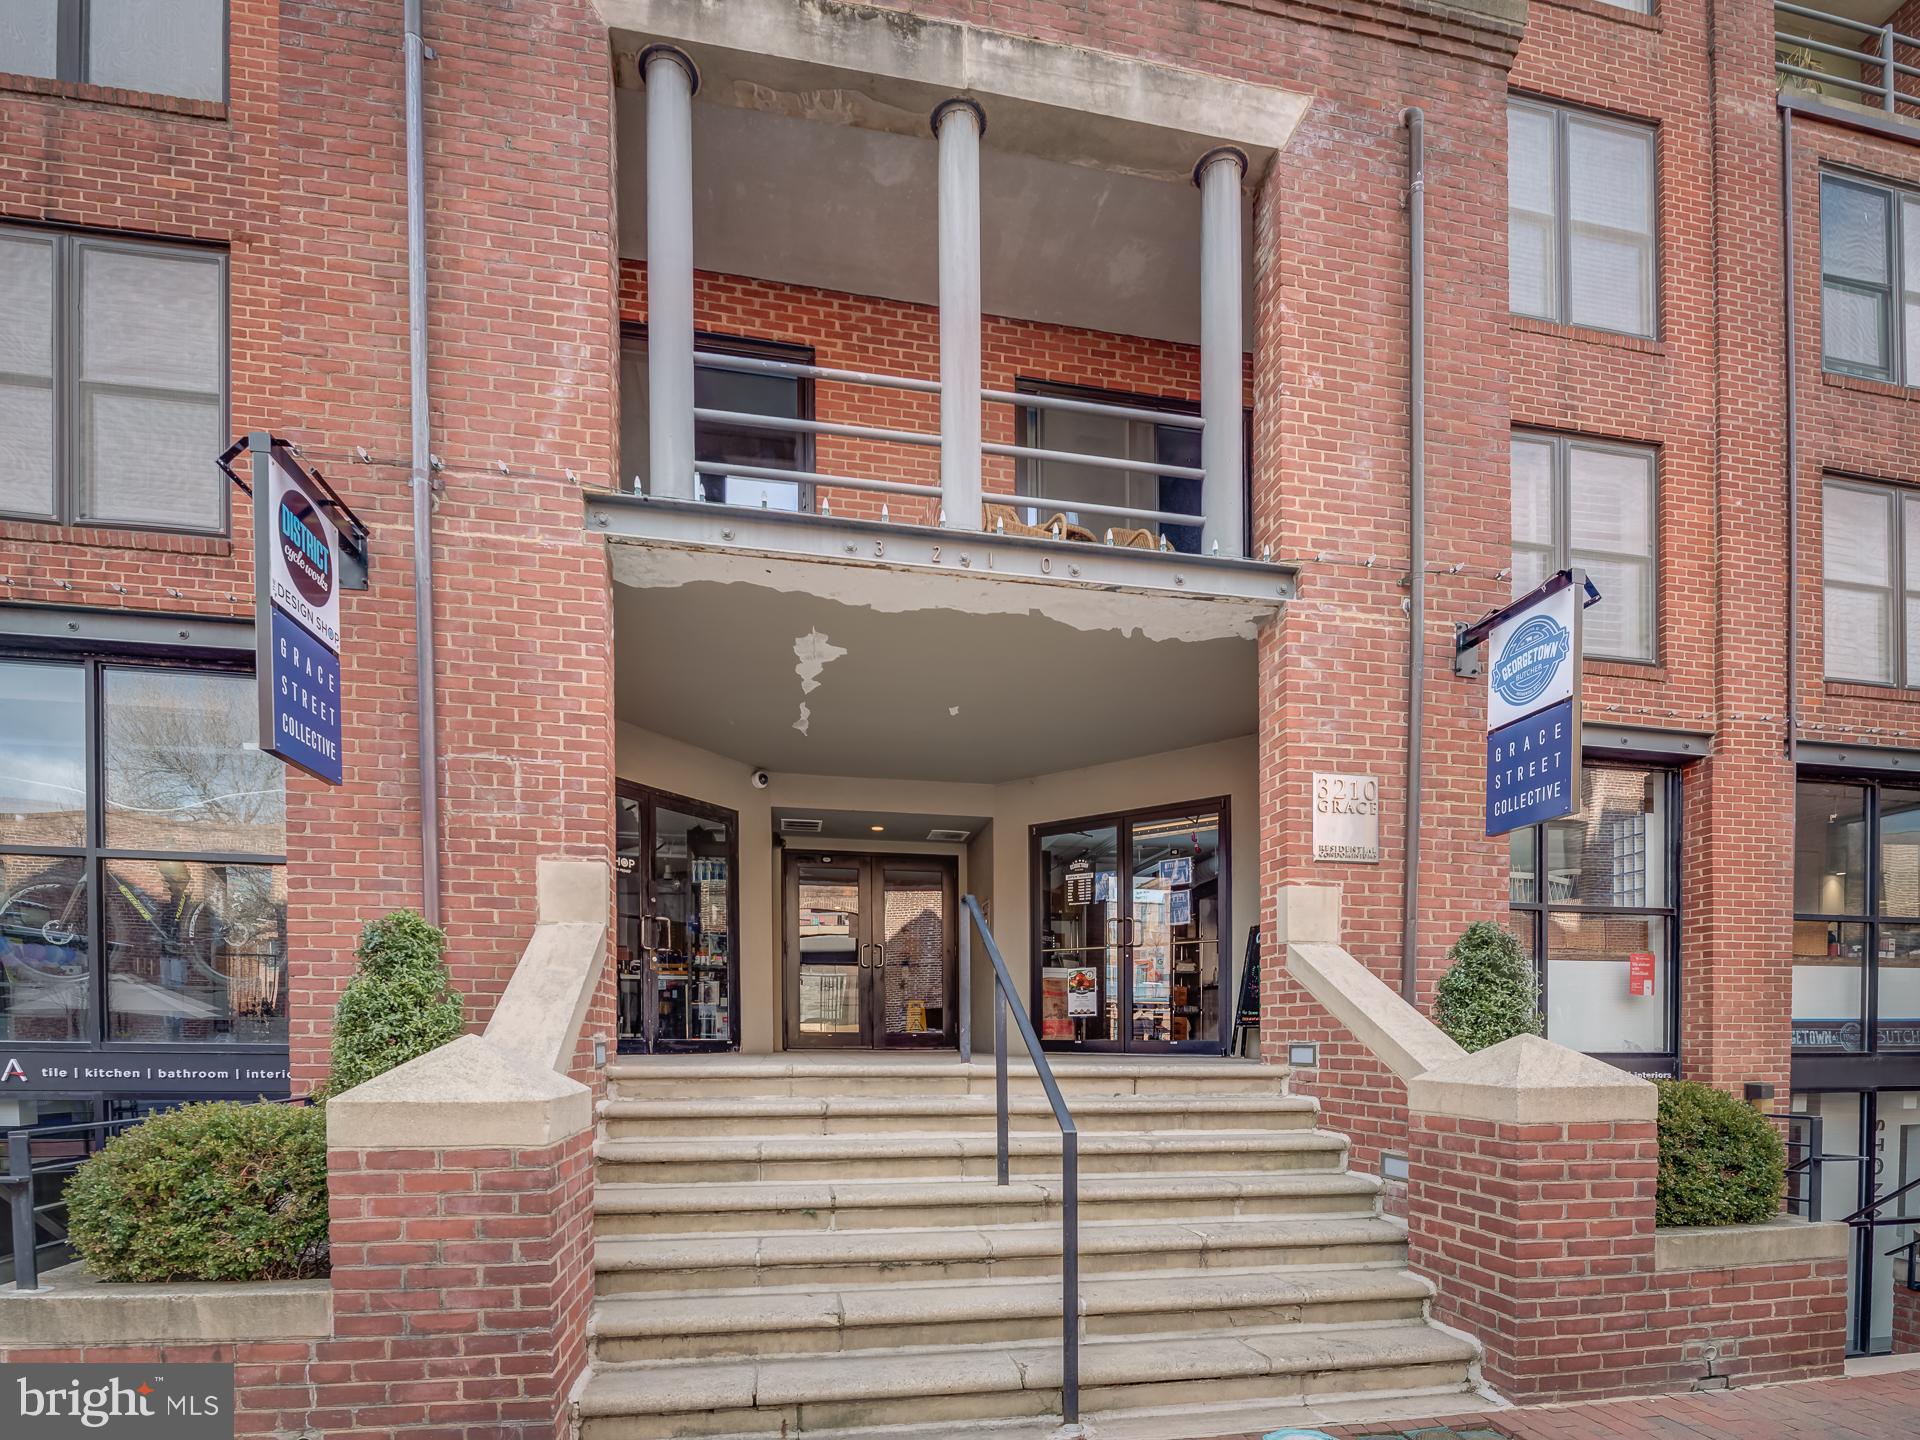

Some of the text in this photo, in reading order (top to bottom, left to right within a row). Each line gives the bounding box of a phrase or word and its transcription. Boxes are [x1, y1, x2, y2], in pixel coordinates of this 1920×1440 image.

[281, 503, 329, 575] DISTRICT
[284, 544, 305, 570] cycle
[304, 563, 328, 592] works
[277, 583, 314, 624] DESIGN
[316, 616, 340, 645] SHOP
[280, 637, 335, 693] GRACE
[1501, 641, 1559, 681] GEORGETOWN
[1515, 663, 1543, 682] BUTCHER
[281, 675, 335, 726] STREET
[282, 713, 336, 760] COLLECTIVE
[1495, 723, 1561, 762] GRACE
[1317, 778, 1377, 801] 3210
[1495, 752, 1561, 789] STREET
[1317, 800, 1377, 815] GRACE
[1494, 781, 1561, 817] COLLECTIVE
[41, 1067, 68, 1078] tile
[85, 1067, 141, 1078] kitchen
[158, 1068, 229, 1079] bathroom
